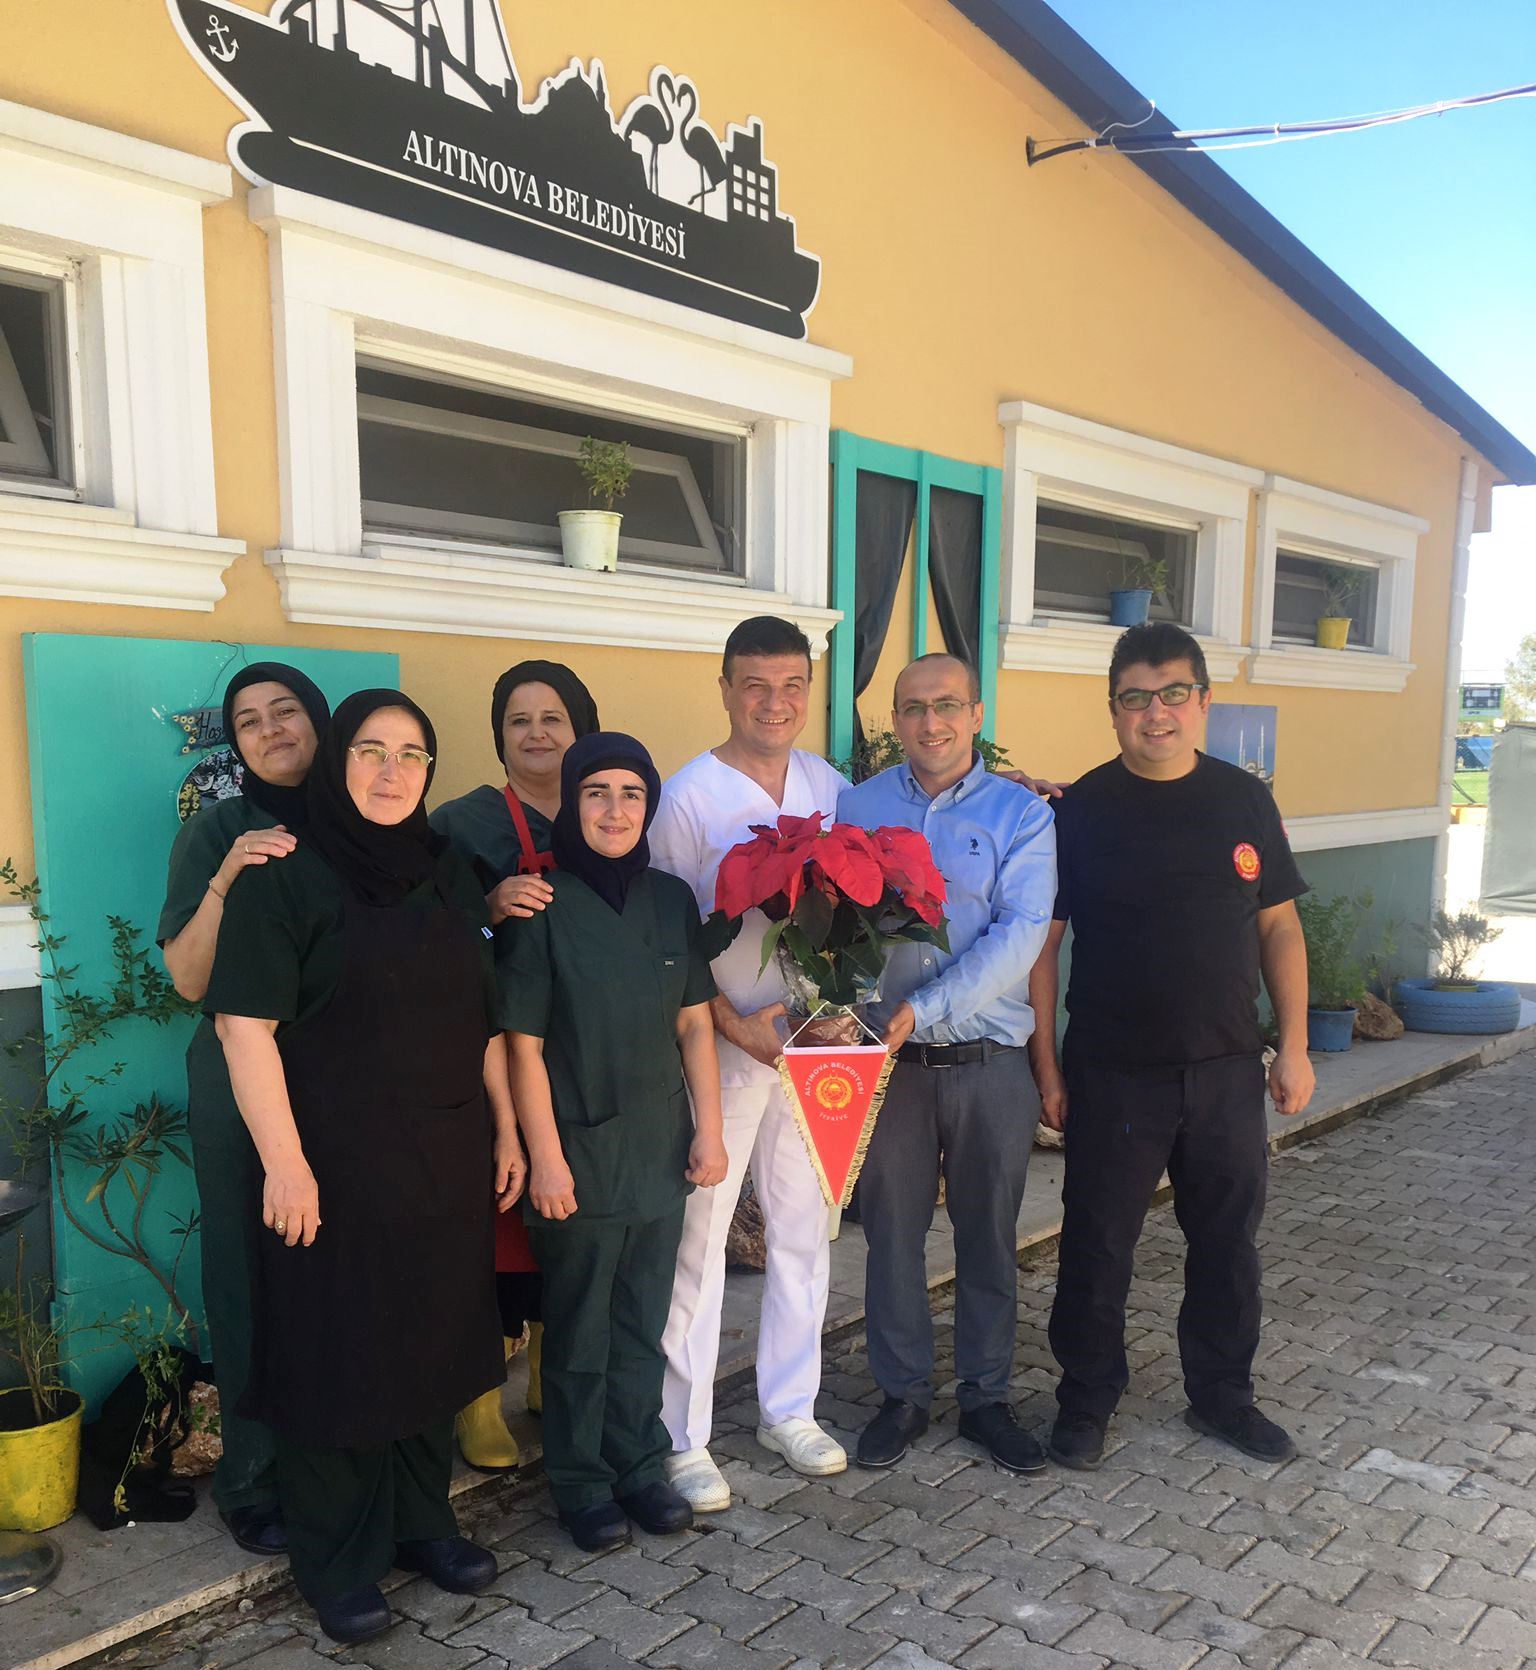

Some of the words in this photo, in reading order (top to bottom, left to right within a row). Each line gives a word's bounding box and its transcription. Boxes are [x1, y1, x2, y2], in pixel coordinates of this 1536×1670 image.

[403, 130, 542, 208] ALTINOVA
[547, 181, 686, 260] BELEDİYESİ
[804, 1063, 829, 1097] ALTINOVA
